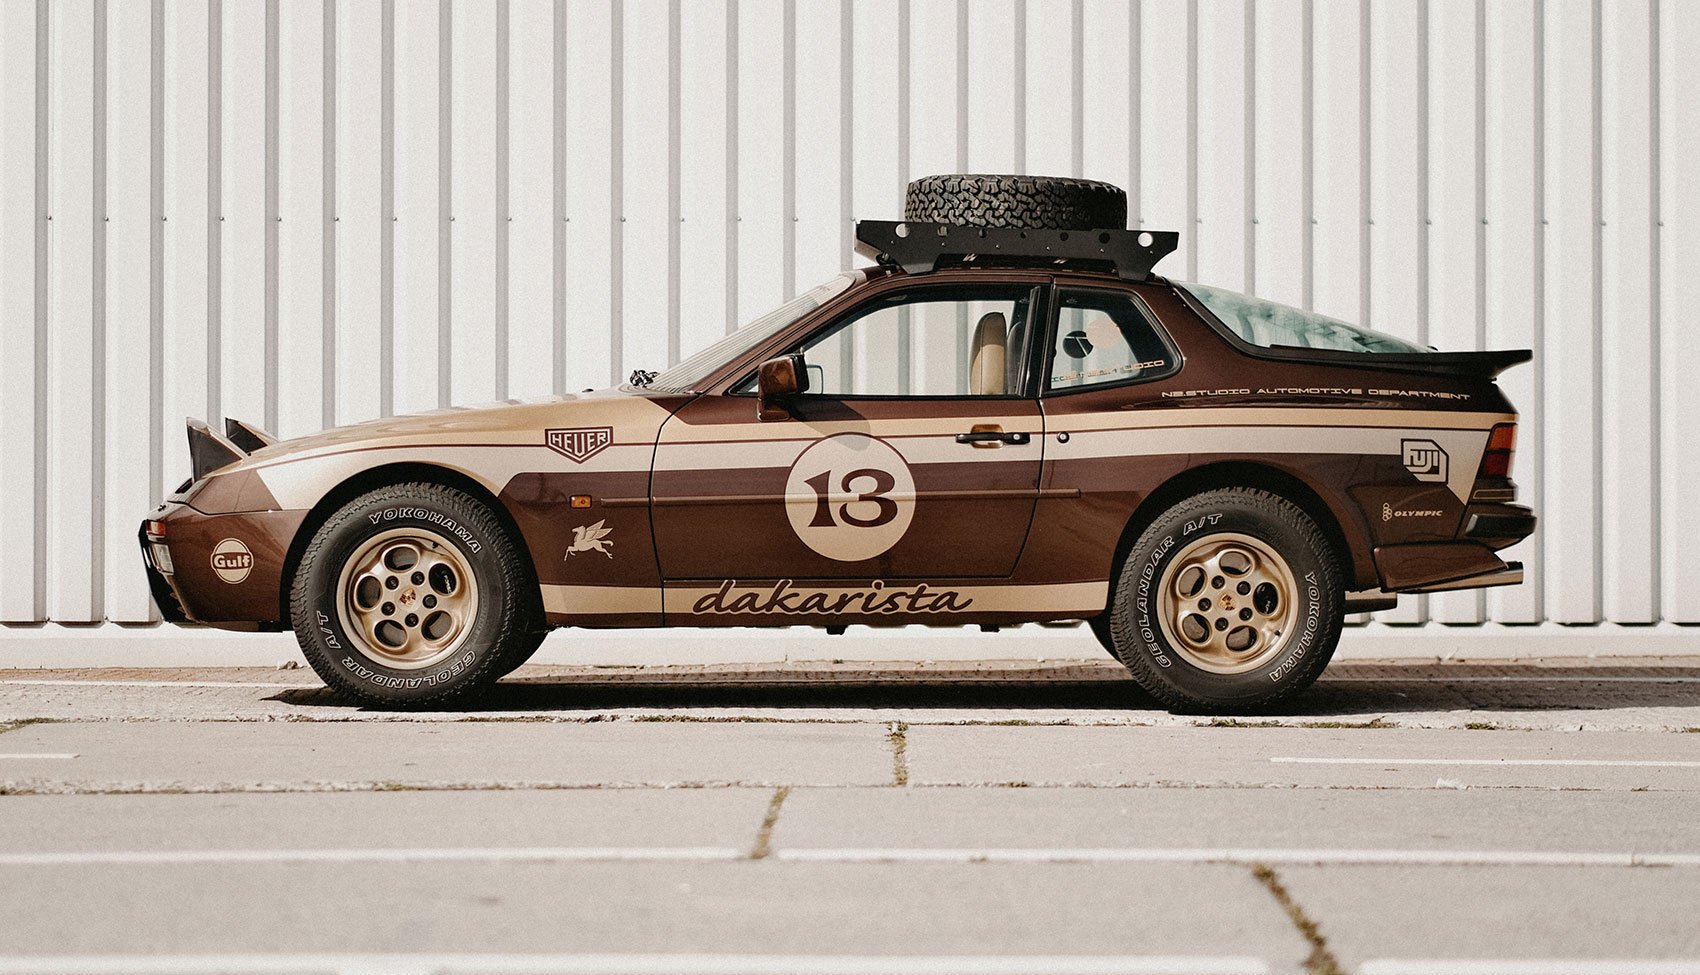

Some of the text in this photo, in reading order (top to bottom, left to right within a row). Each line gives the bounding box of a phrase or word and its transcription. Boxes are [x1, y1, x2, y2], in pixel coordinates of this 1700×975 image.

[1368, 389, 1471, 400] DEPARTMENT
[551, 432, 607, 457] HEUER
[1403, 441, 1443, 475] FUJI
[803, 468, 898, 528] 13
[368, 508, 482, 553] YOKOHAMA
[213, 555, 250, 568] Gulf
[692, 579, 973, 615] dakarista
[1136, 513, 1223, 668] GEOLANDAR A/T
[1268, 571, 1321, 682] YOKOHAMA
[316, 611, 476, 688] GEOLANDAR A/T
